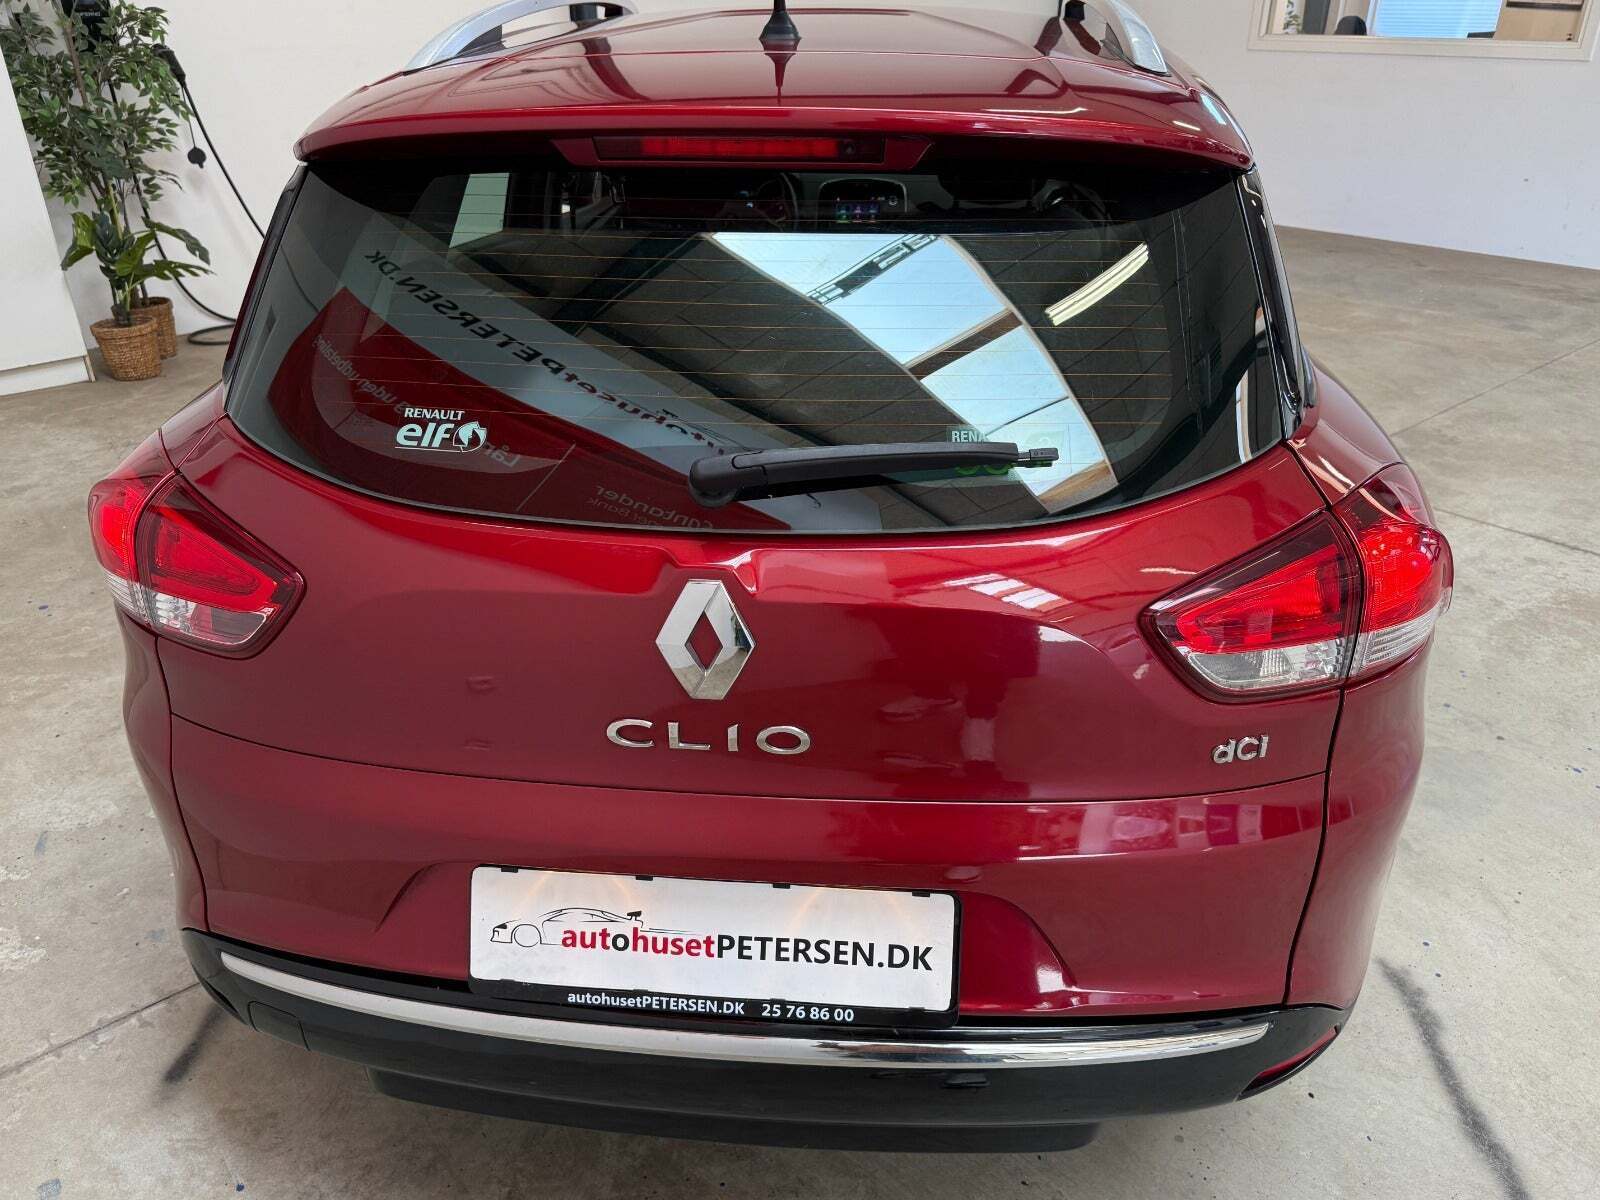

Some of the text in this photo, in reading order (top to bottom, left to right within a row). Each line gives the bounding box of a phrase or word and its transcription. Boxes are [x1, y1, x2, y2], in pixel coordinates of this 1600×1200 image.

[404, 408, 465, 420] RENAULT
[395, 422, 454, 448] elf
[606, 718, 811, 755] CLIO
[561, 926, 933, 972] autohusetPETERSEN.DK
[567, 991, 855, 1022] autohusetPETERSEN.DK 25 76 86 00
